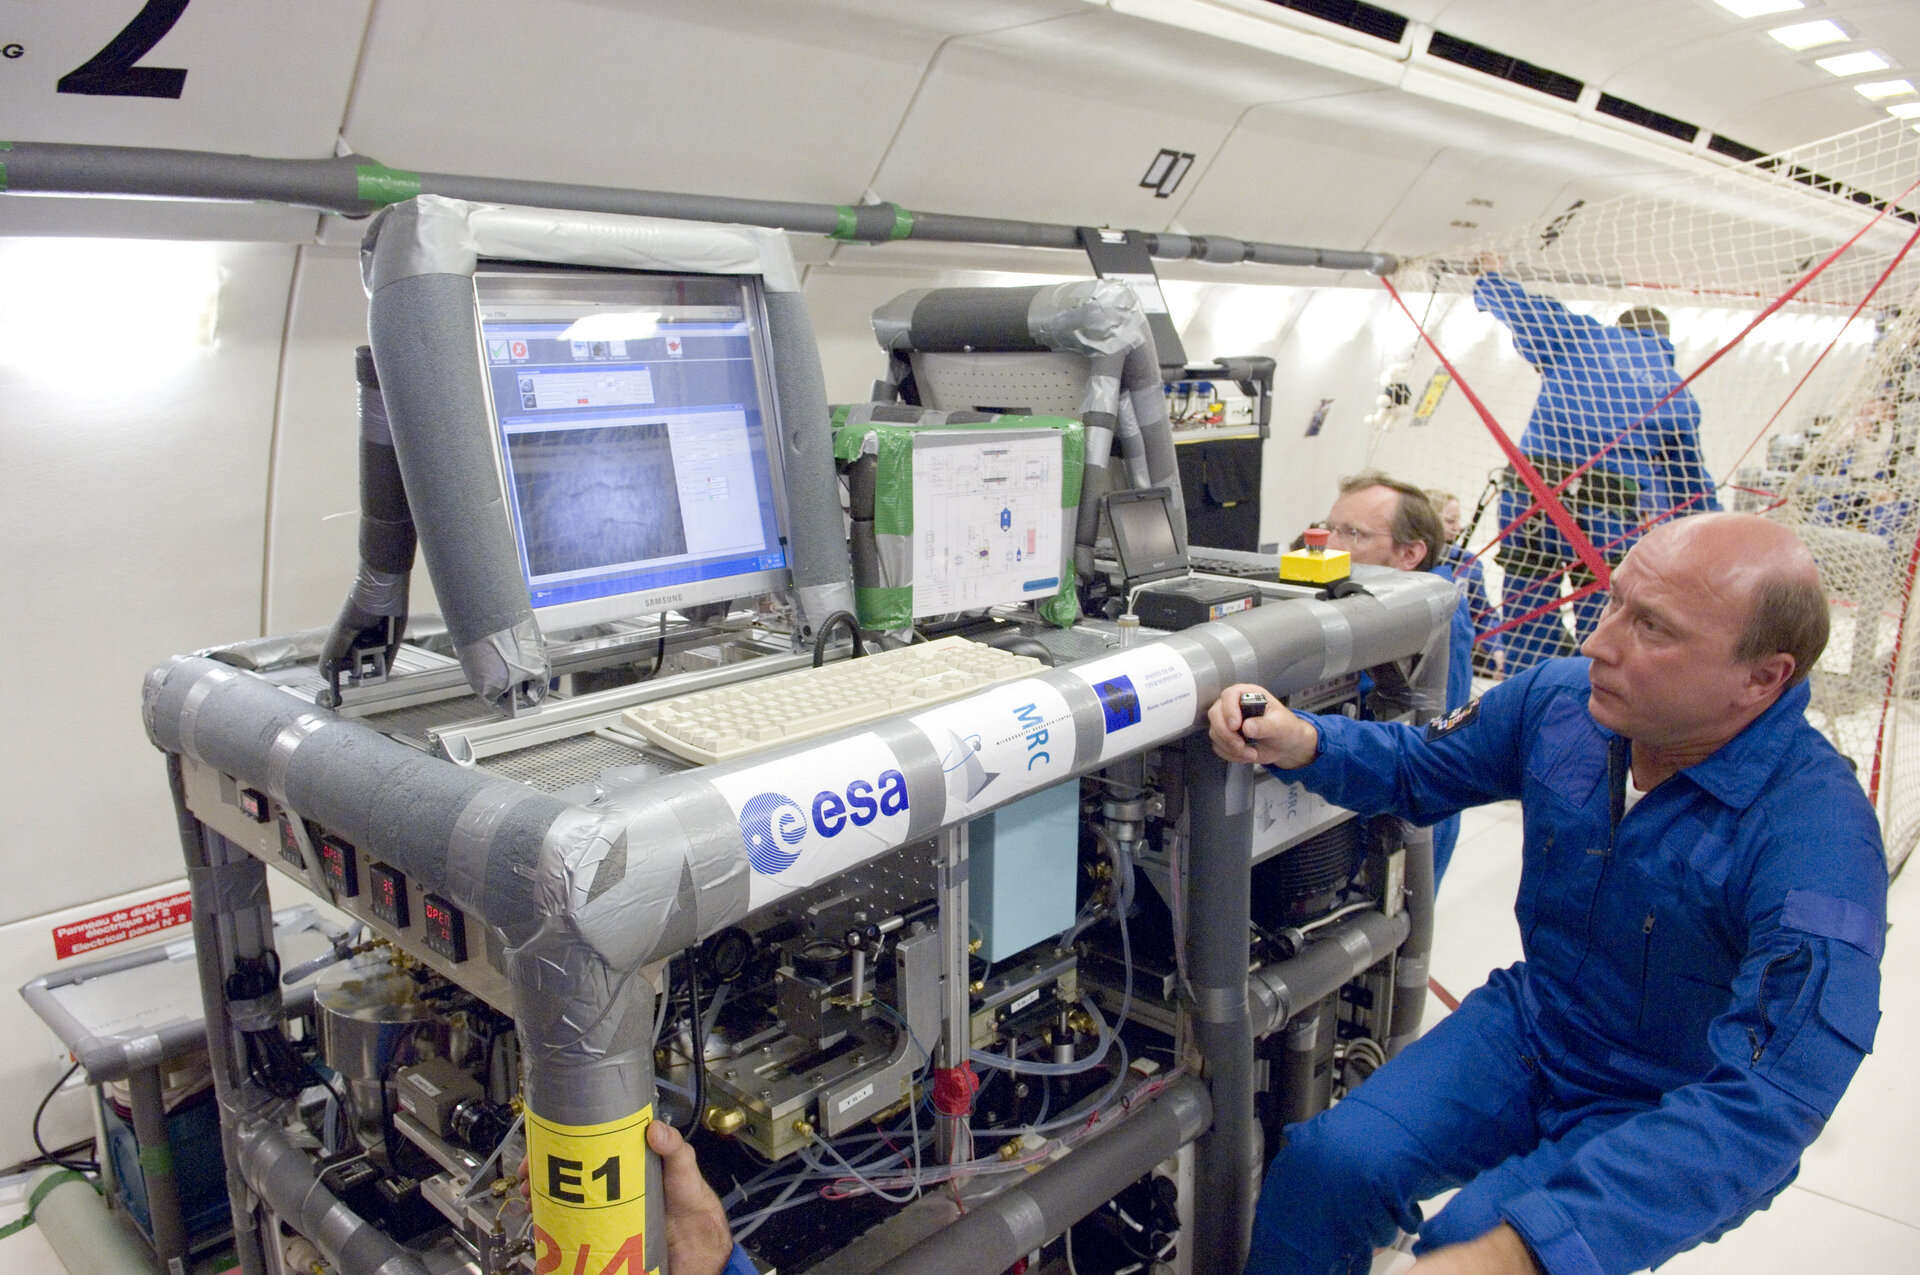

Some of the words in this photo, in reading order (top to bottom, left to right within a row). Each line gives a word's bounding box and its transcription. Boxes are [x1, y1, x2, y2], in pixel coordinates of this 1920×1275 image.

[56, 0, 190, 99] 2
[645, 593, 683, 607] SAMSUNG
[1012, 703, 1050, 771] MRC
[1032, 720, 1055, 732] RESEARCH
[812, 769, 909, 838] esa
[1287, 785, 1298, 819] MRC
[383, 879, 394, 895] 35
[57, 917, 110, 938] Panneau
[112, 911, 128, 922] de
[130, 894, 192, 918] distribution
[71, 932, 126, 954] Electrical
[128, 921, 161, 939] panel
[178, 913, 187, 922] 2
[85, 916, 144, 939] électrique
[161, 908, 170, 917] 2
[547, 1153, 620, 1204] E1
